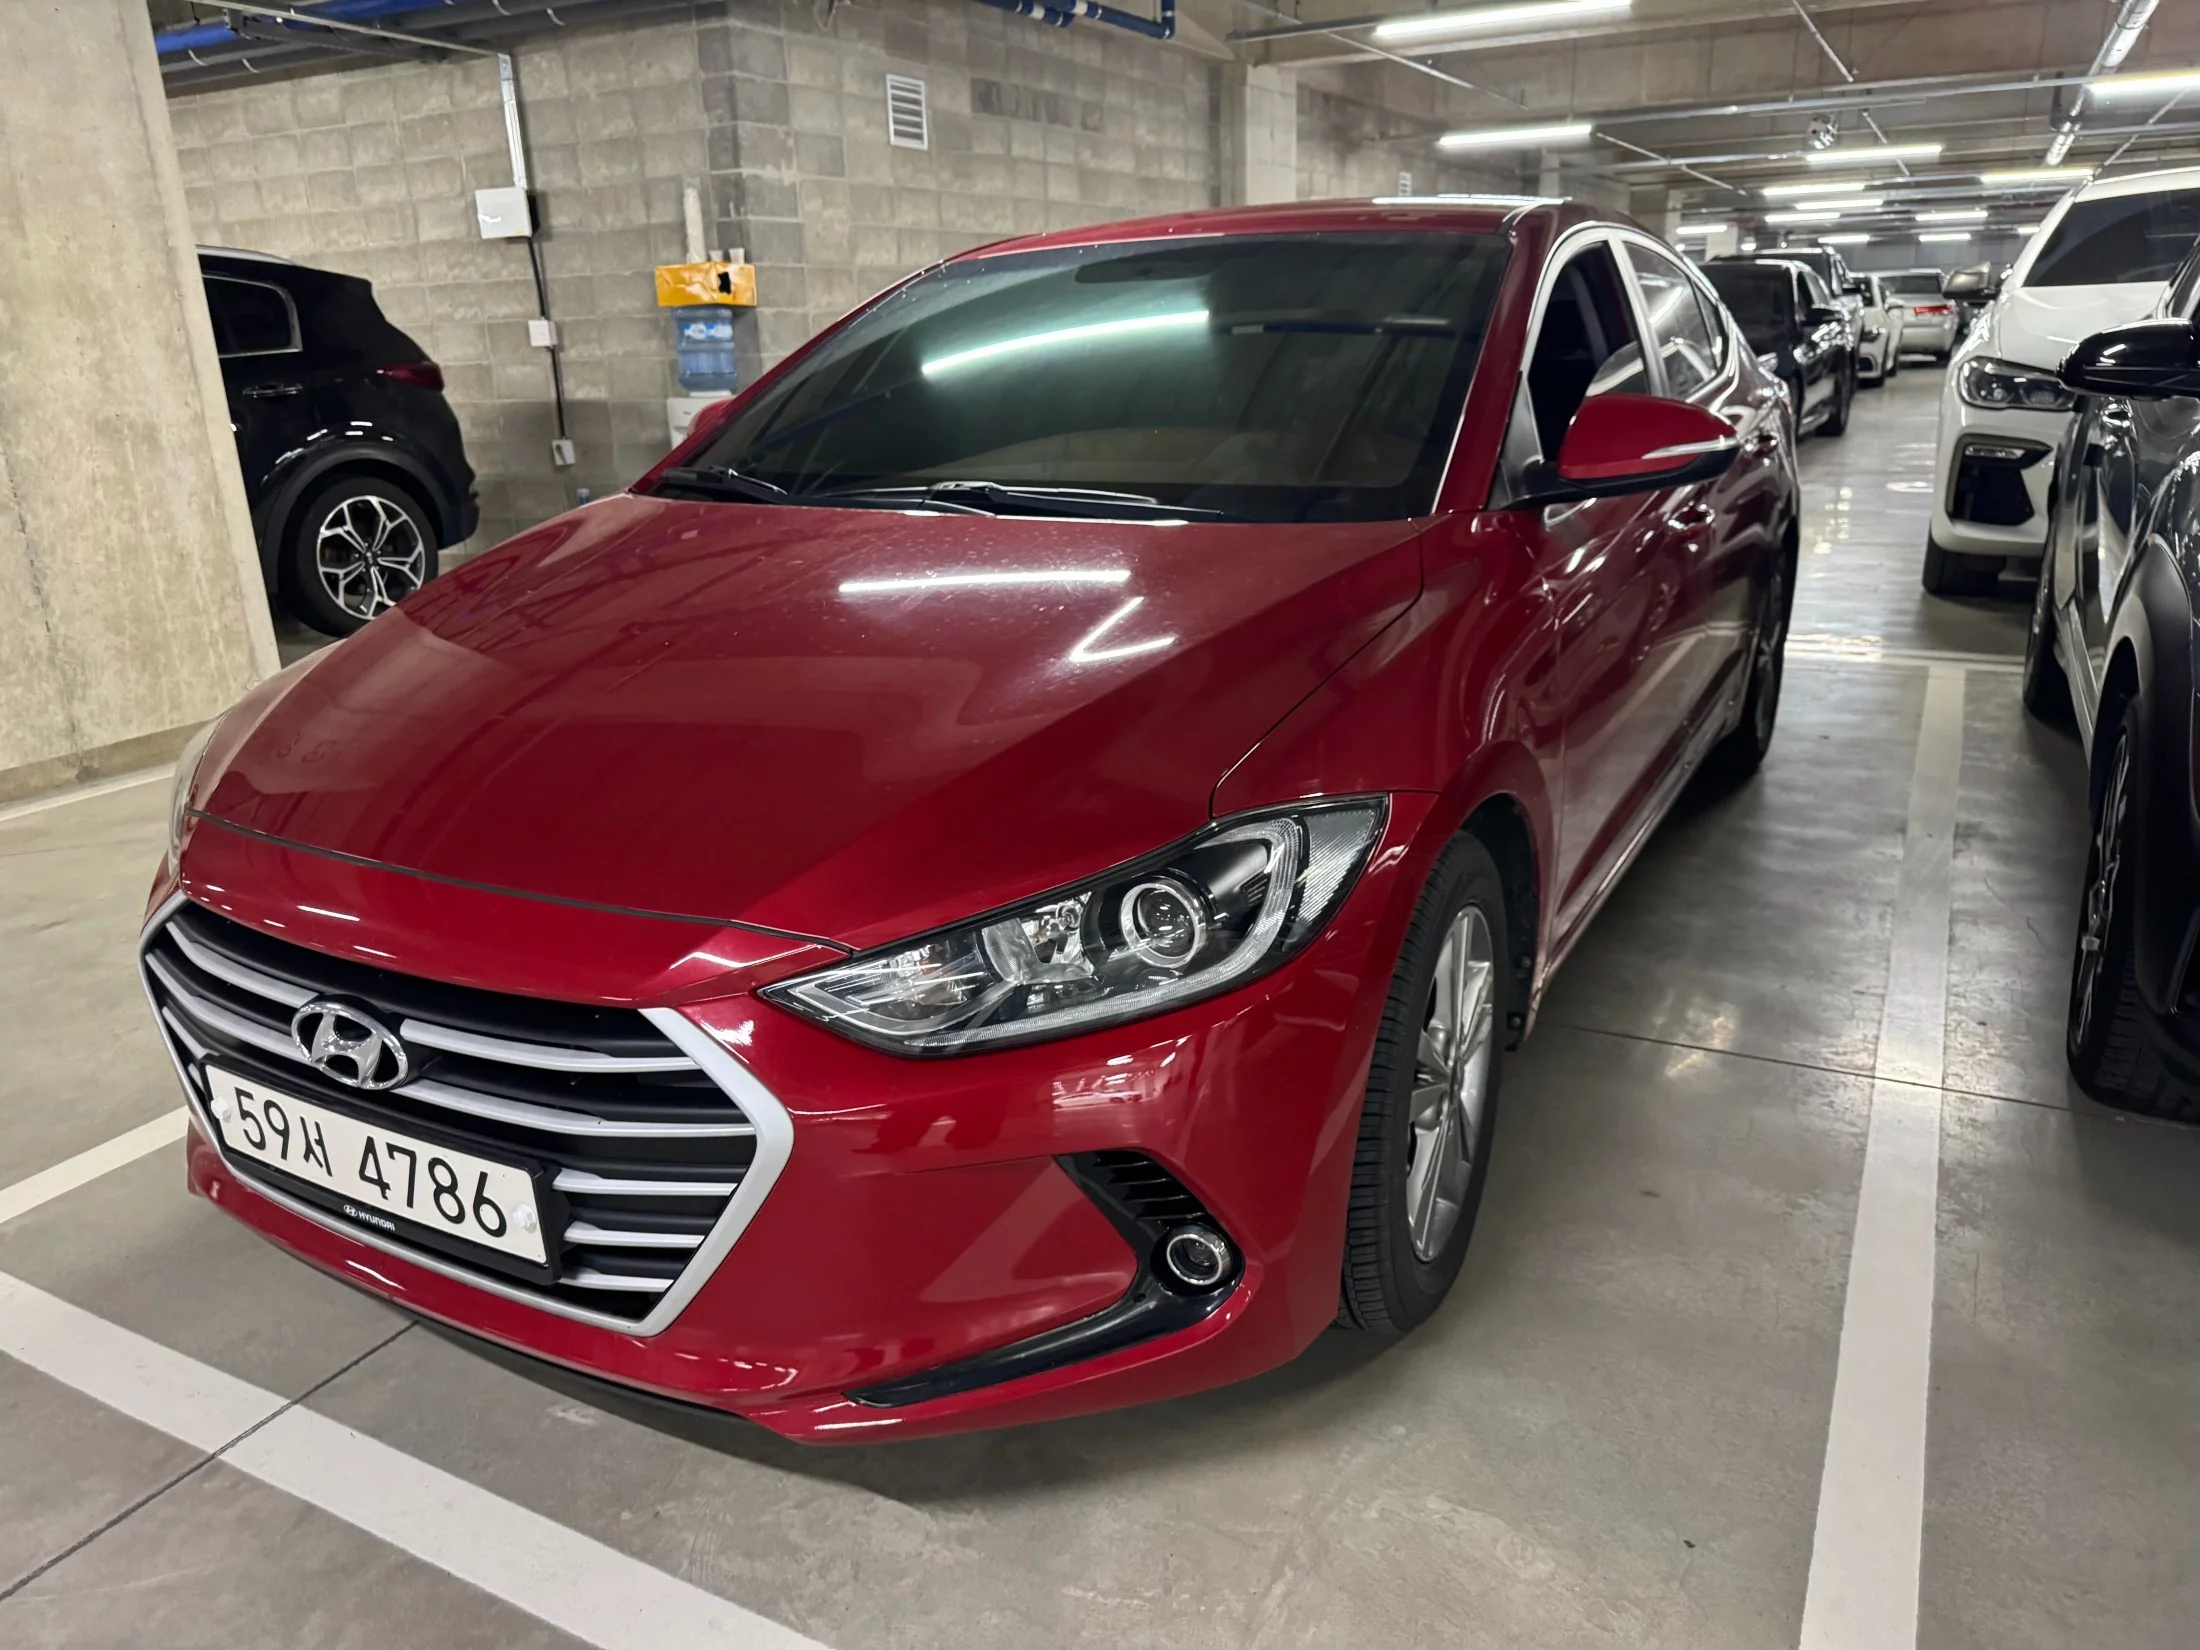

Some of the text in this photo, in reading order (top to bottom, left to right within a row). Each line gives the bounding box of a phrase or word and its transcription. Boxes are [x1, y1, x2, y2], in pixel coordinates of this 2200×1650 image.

[234, 1086, 507, 1238] 59서 4786
[358, 1210, 396, 1232] HYUNDAI
